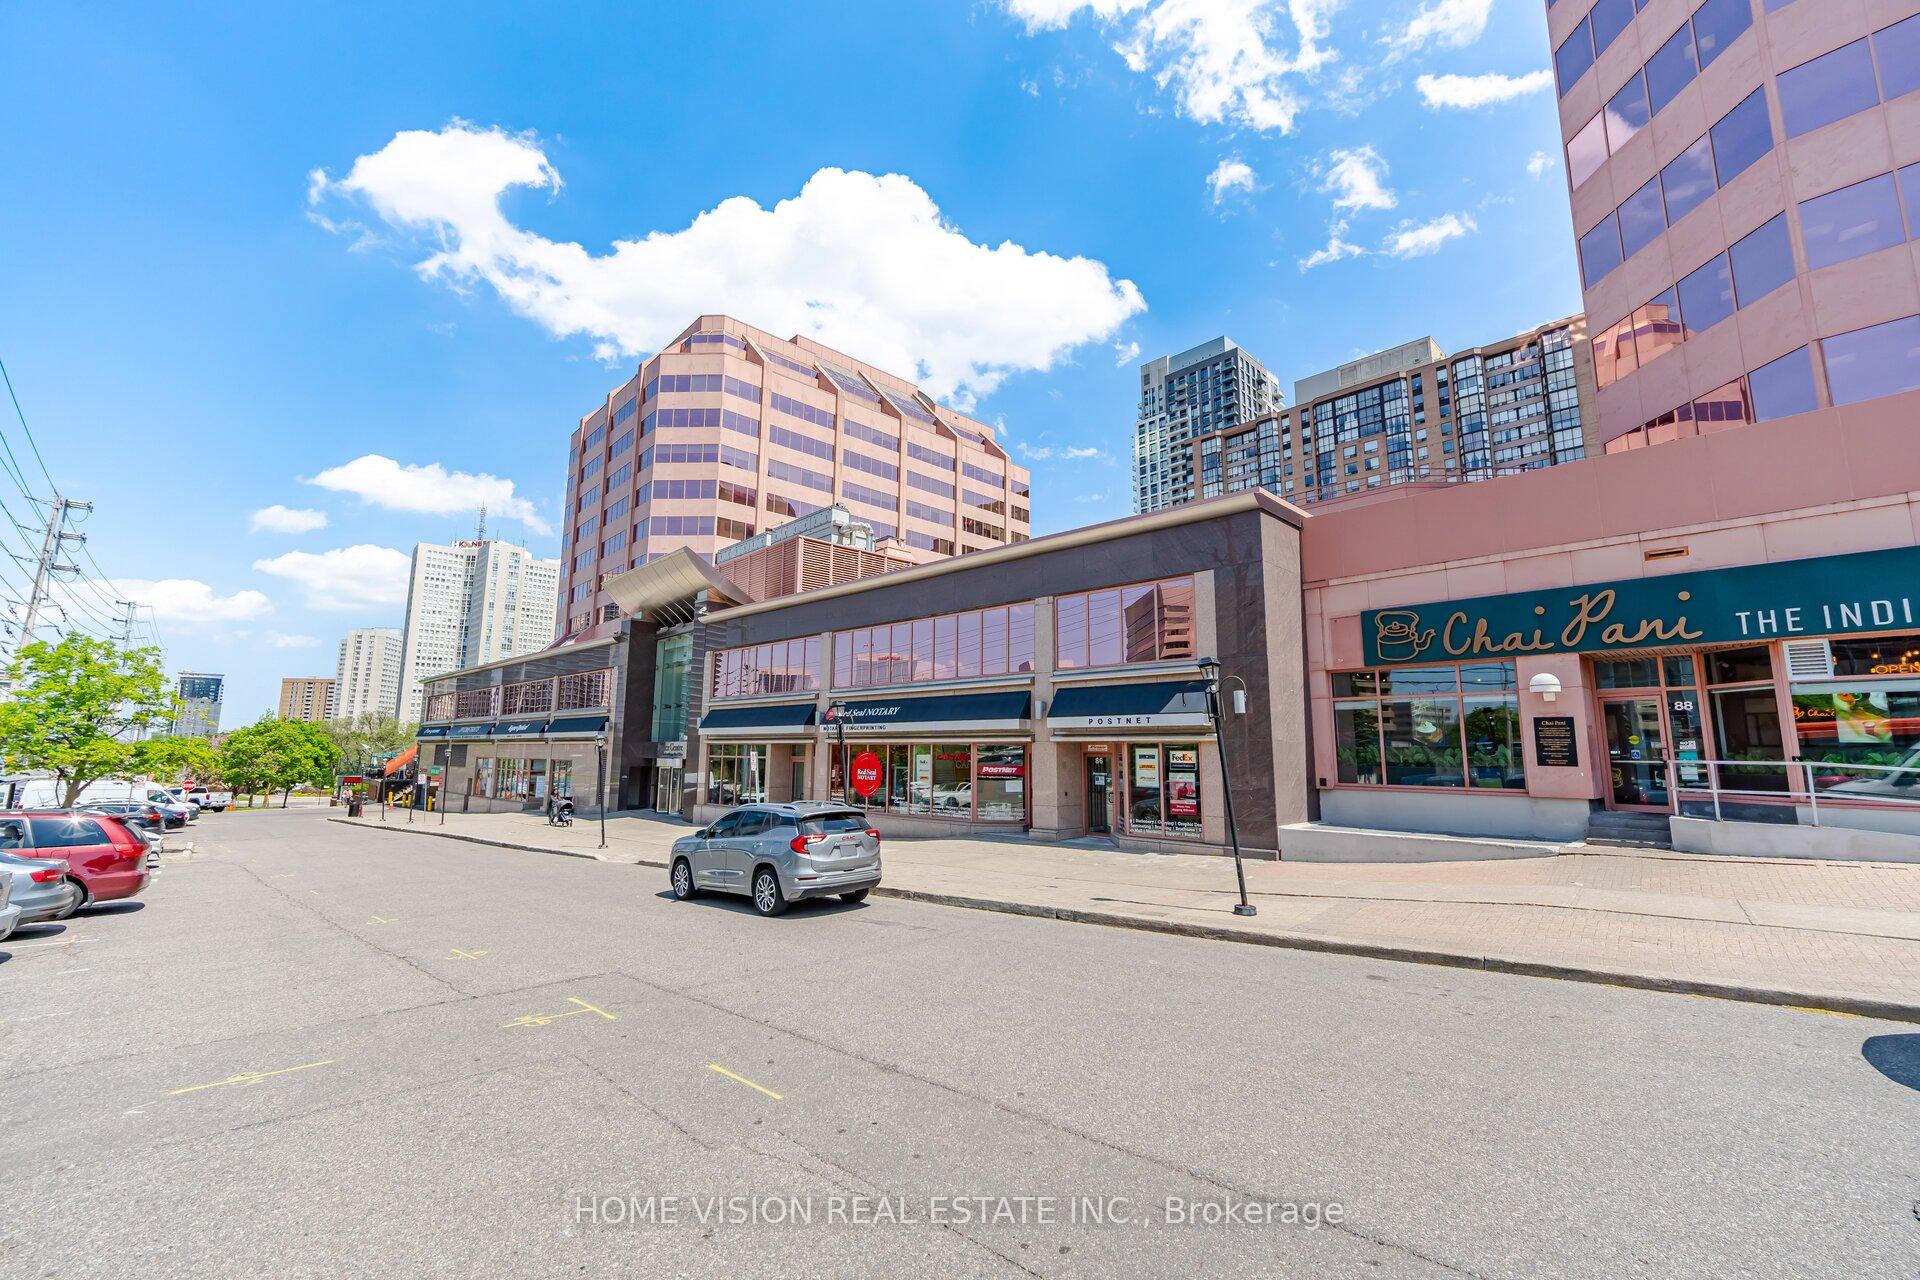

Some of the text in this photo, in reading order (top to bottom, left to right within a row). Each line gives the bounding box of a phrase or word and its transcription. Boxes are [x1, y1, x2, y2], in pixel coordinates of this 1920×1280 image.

[1735, 598, 1913, 635] THE INDI
[1443, 590, 1703, 655] Chai Pani
[1875, 664, 1920, 673] OPEN
[1674, 701, 1694, 711] 88
[852, 708, 866, 717] Seal
[865, 706, 900, 717] NOTARY
[1088, 717, 1151, 725] POSTNET
[1172, 753, 1193, 762] FedEx
